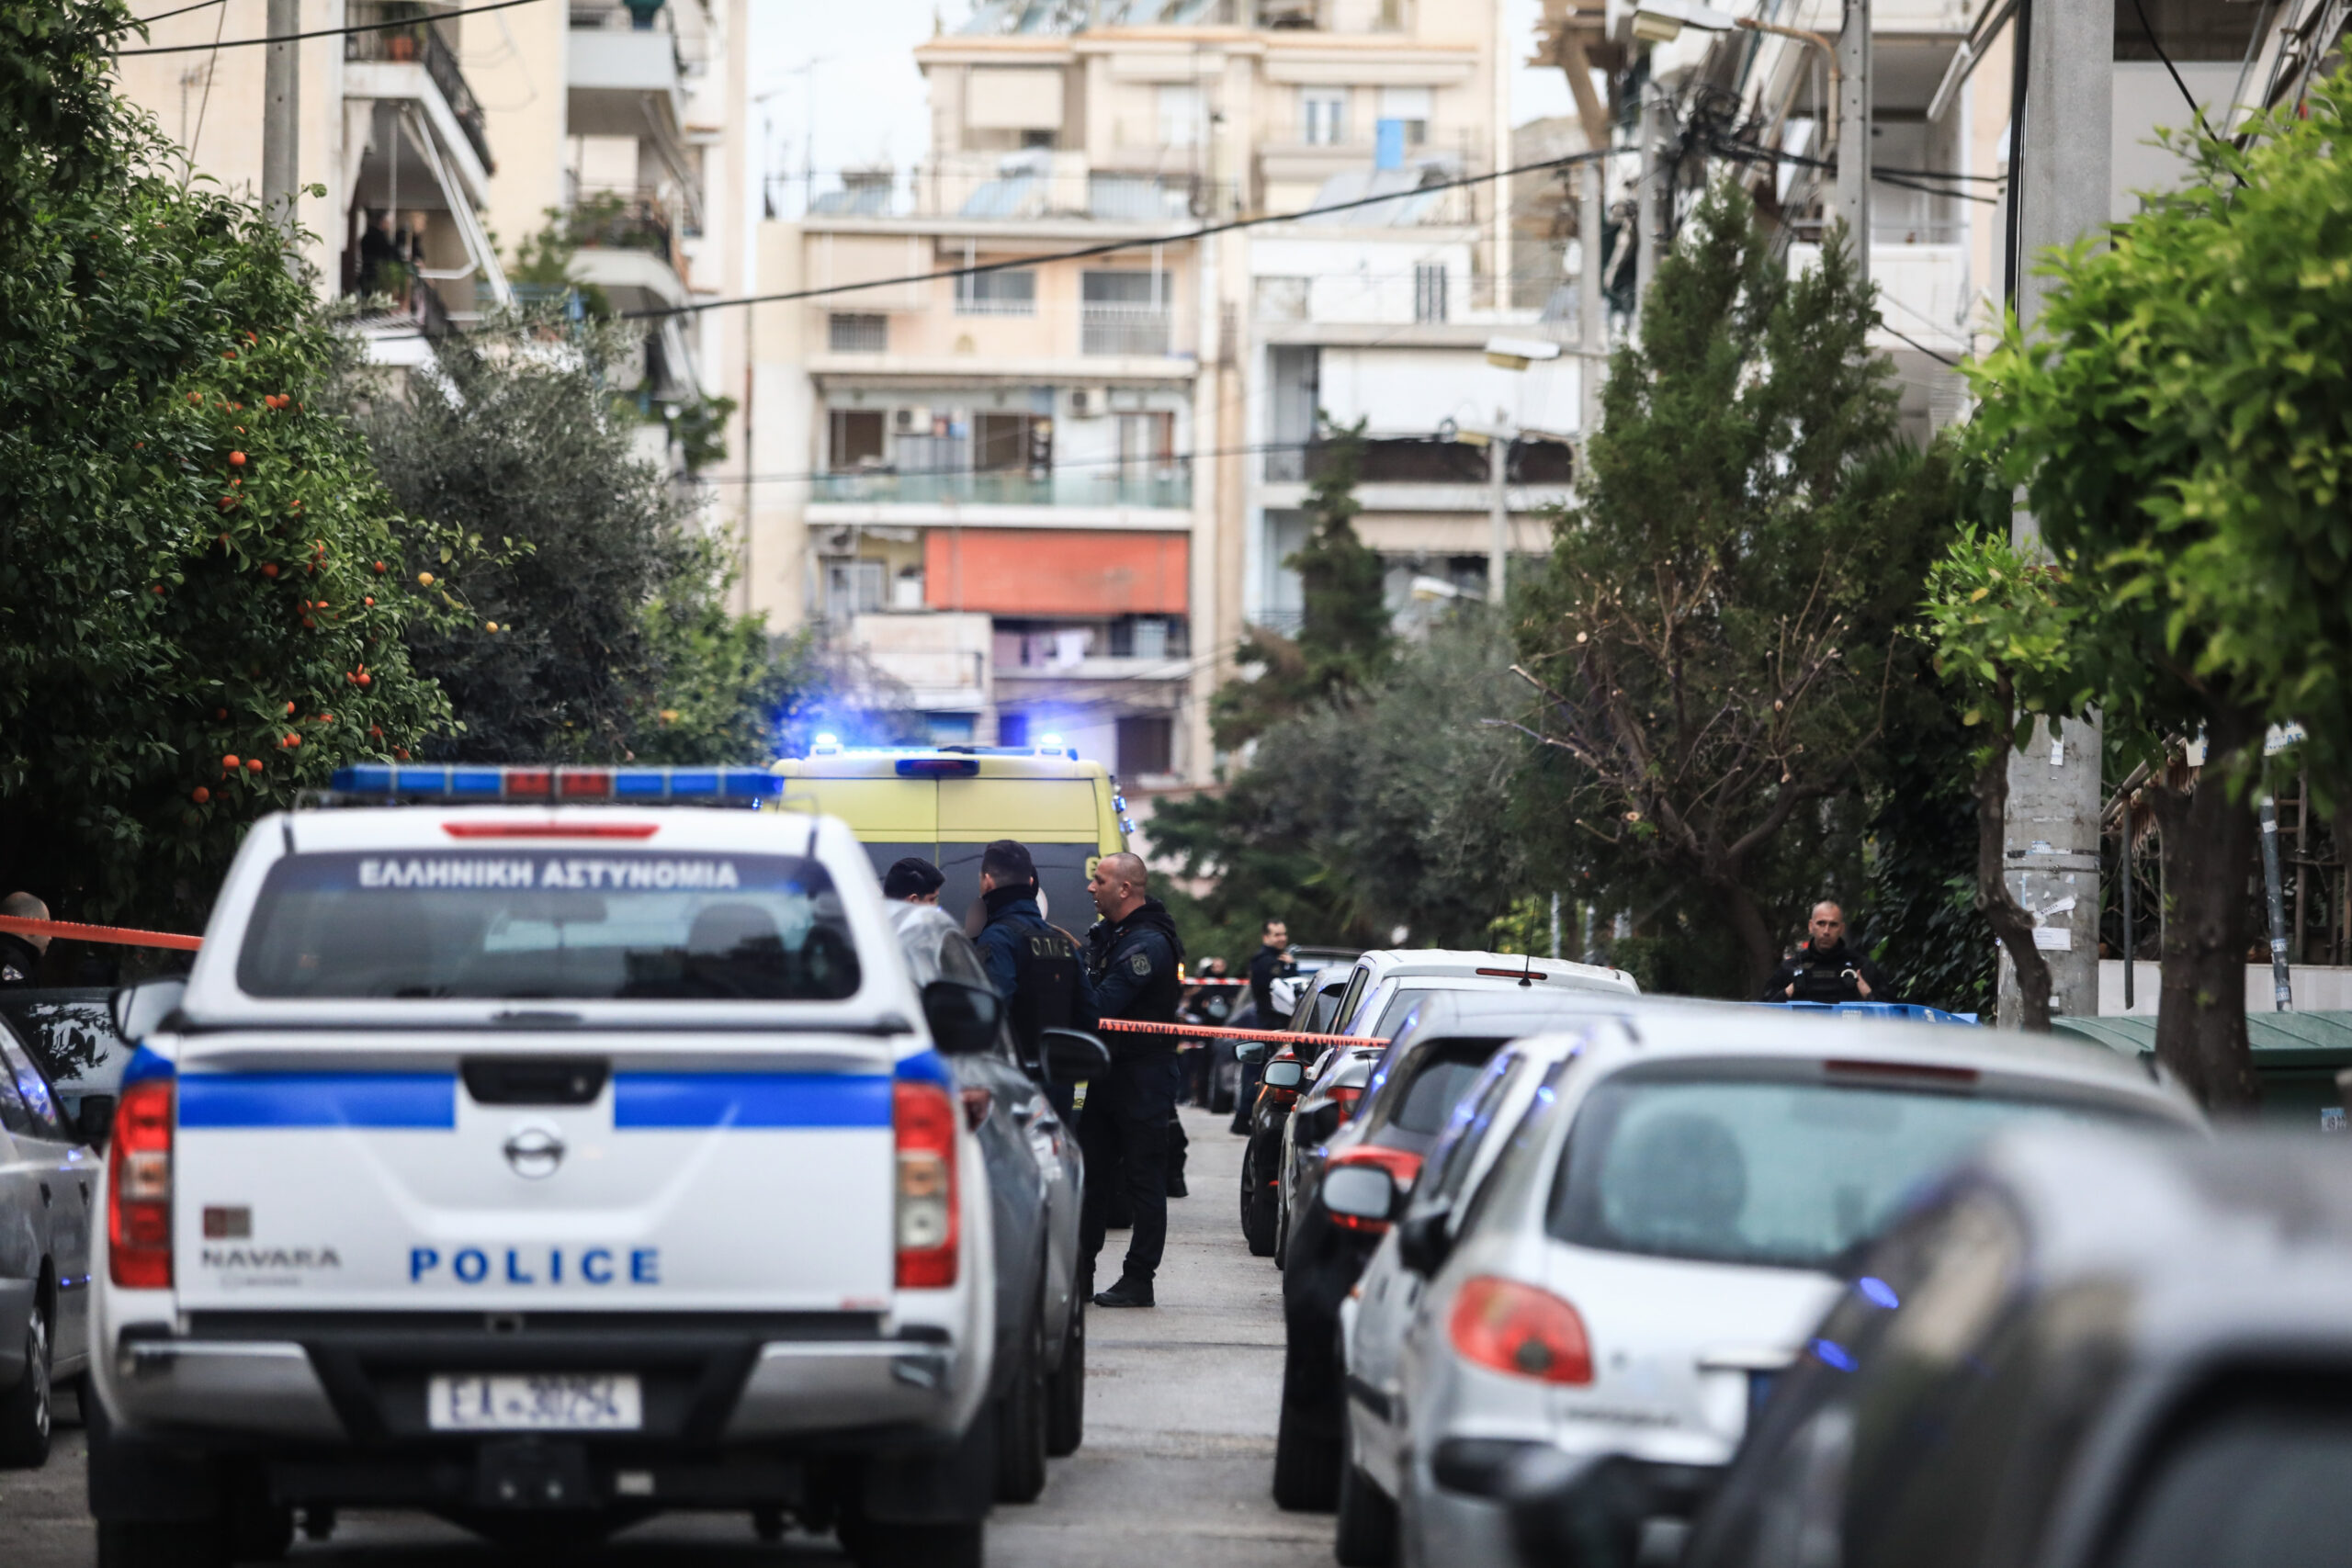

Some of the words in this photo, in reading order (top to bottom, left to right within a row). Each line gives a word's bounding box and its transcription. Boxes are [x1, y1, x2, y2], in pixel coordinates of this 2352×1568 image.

[359, 860, 533, 888] ΕΛΛΗΝΙΚΗ
[540, 861, 740, 889] ΑΣΤΥΝΟΜΙΑ
[201, 1247, 343, 1269] NAVARA
[409, 1247, 661, 1284] POLICE
